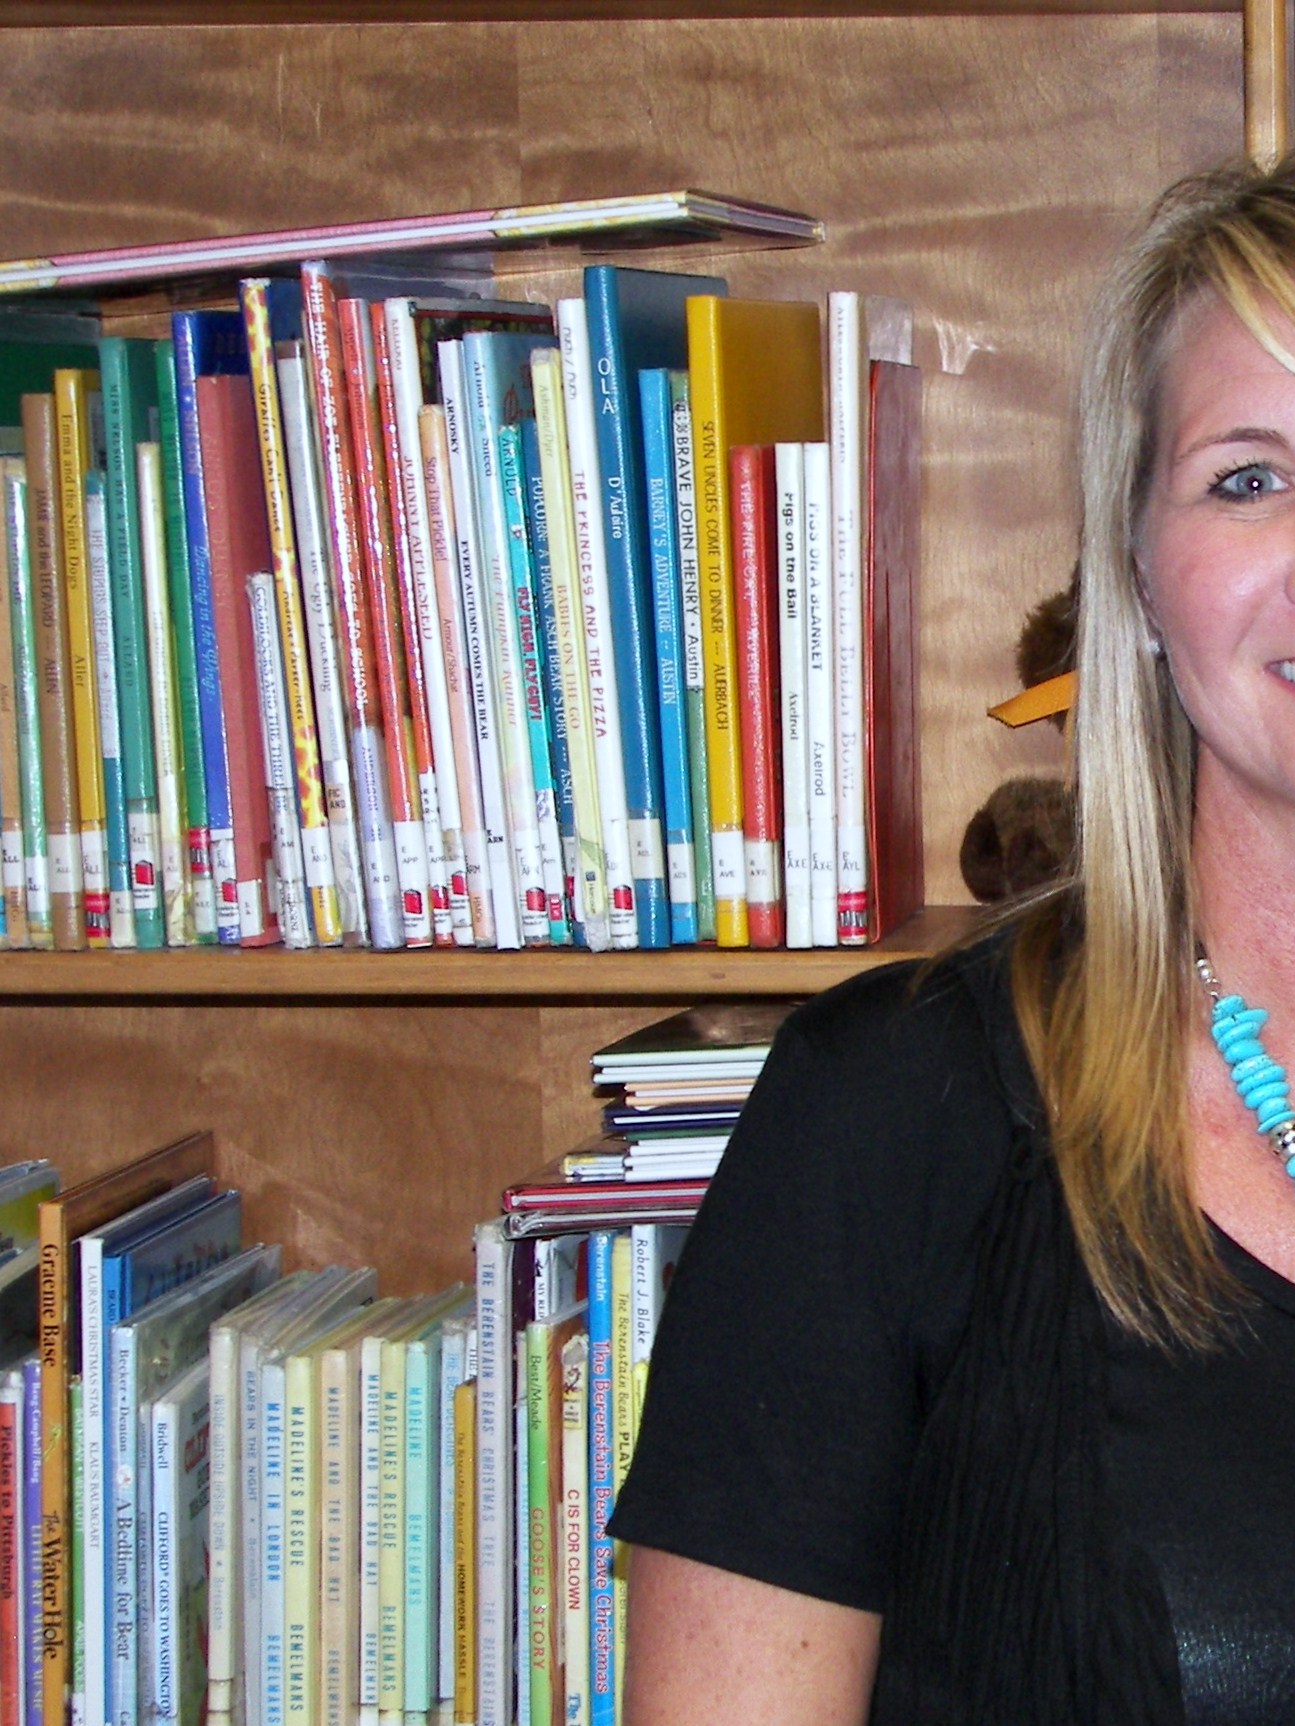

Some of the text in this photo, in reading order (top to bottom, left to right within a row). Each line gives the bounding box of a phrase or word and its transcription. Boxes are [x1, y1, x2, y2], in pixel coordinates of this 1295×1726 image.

[446, 397, 460, 455] ARNOSKY
[424, 456, 447, 562] Stop That Pickle!
[676, 436, 701, 680] BRAVE JOHN HENRY Austin
[573, 470, 607, 738] THE PRINCESS AND THE PIZZA
[649, 478, 676, 705] BARNEY'S ADVENTURE AUSTIN
[701, 420, 729, 731] SEVEN UNCLES COME TO DINNER AUERBACH
[460, 540, 489, 741] EVERY AUTUMN COMES THE BEAR
[41, 1244, 60, 1368] Graeme Base
[635, 1239, 649, 1345] Robert J. Blake
[156, 1422, 169, 1470] Bridwell
[530, 1355, 542, 1430] Best/Meade
[567, 1489, 580, 1610] C IS FOR CLOWN
[593, 1340, 612, 1693] The Berenstain Bears Save Christmas
[42, 1510, 63, 1660] The Water Hole
[116, 1498, 133, 1661] A Bedtime for Bear
[158, 1579, 169, 1615] GOES
[158, 1616, 169, 1632] TO
[531, 1507, 545, 1670] GOOSE'S STORY
[158, 1635, 171, 1718] WASHINGTON
